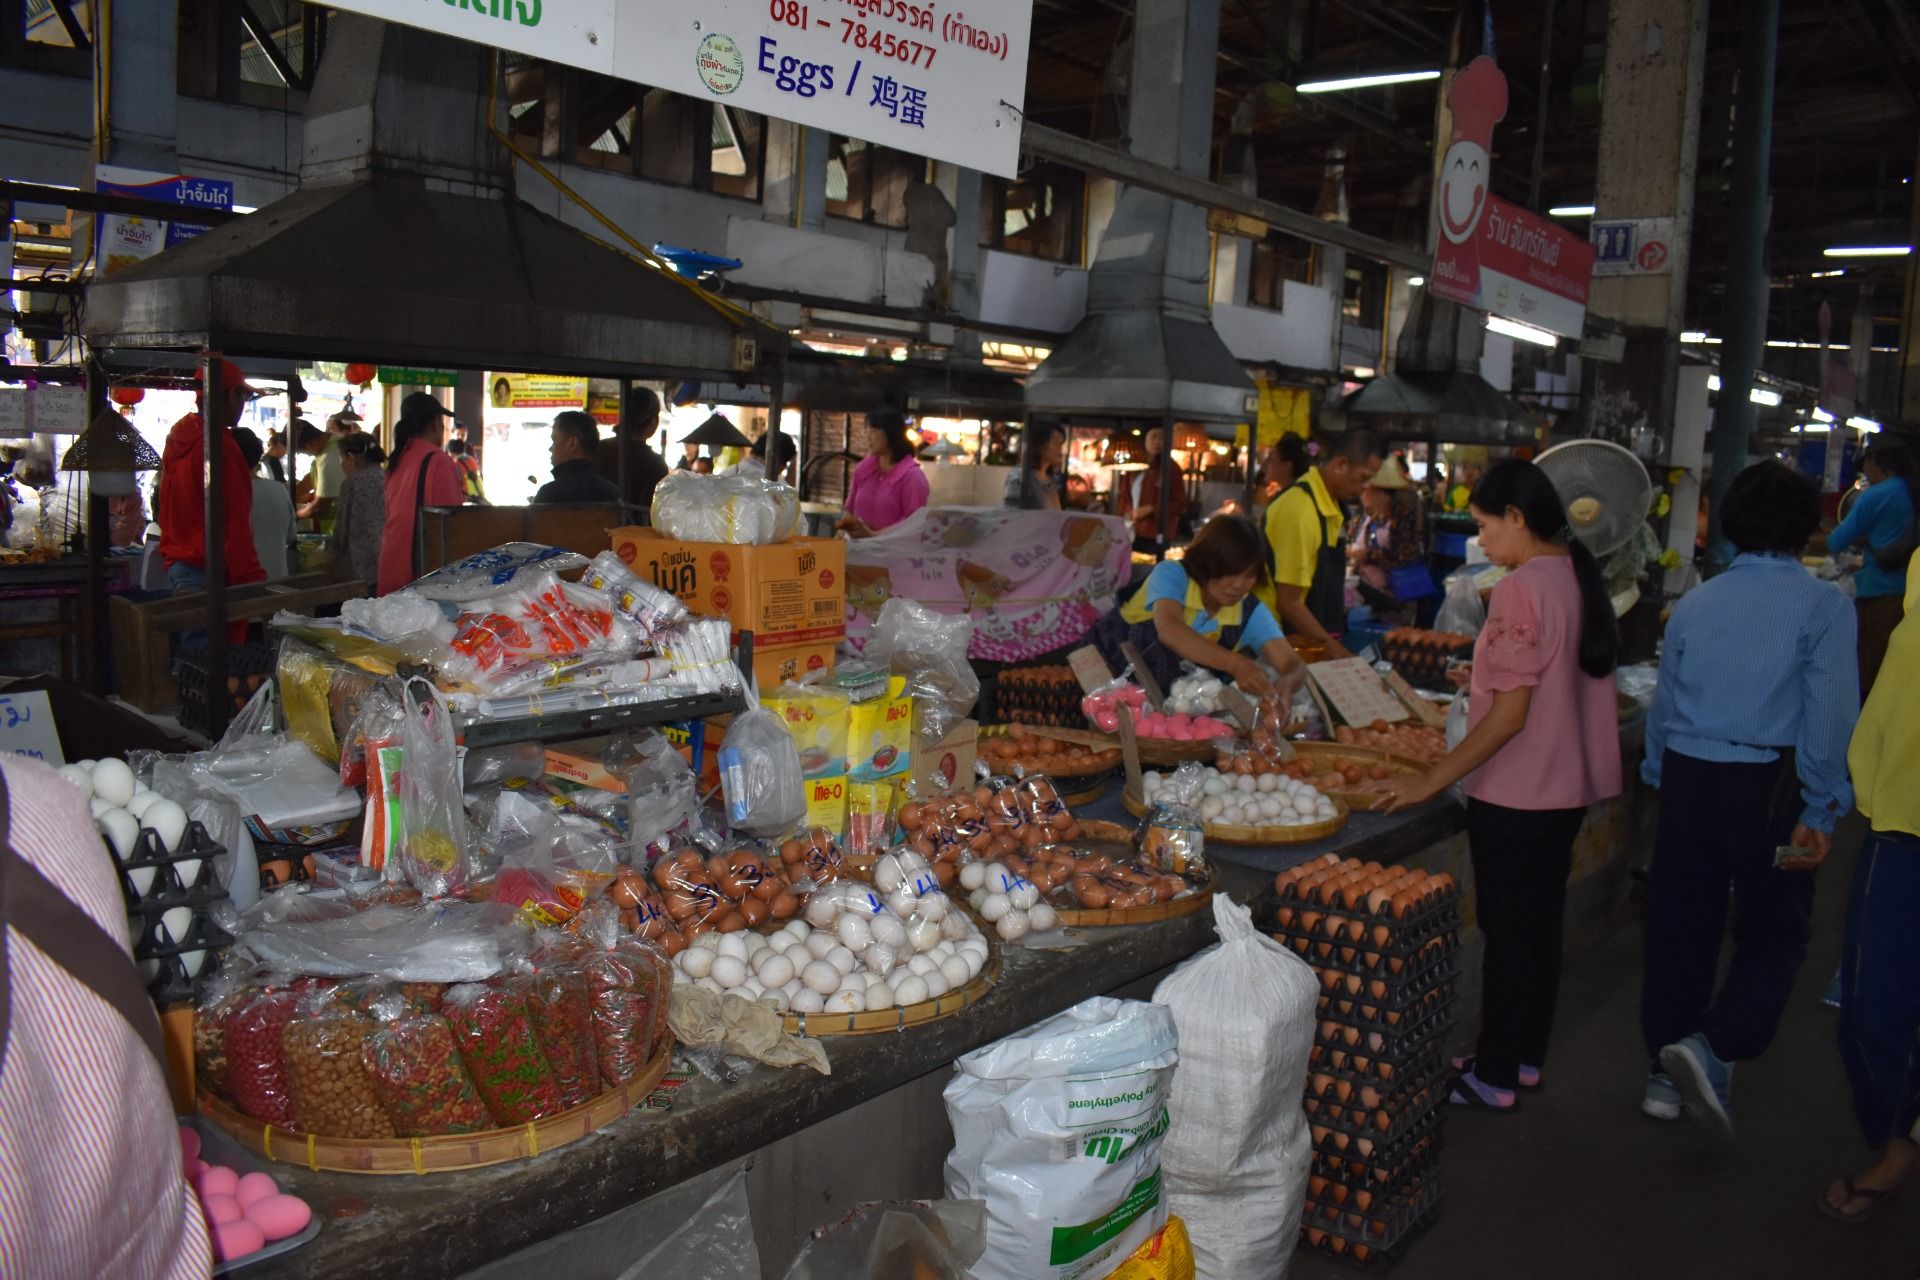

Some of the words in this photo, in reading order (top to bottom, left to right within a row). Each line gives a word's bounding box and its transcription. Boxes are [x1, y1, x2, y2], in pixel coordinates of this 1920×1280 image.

[770, 0, 808, 30] 081
[840, 17, 937, 70] 7845677
[943, 12, 1008, 61] (ทำเอง)
[758, 36, 834, 98] Eggs
[845, 60, 862, 96] /
[869, 75, 928, 129] 鸡蛋
[176, 180, 228, 204] น้ำจิ้มไก่
[1487, 205, 1511, 245] ร้าน
[1068, 1091, 1144, 1110] Polyethylene
